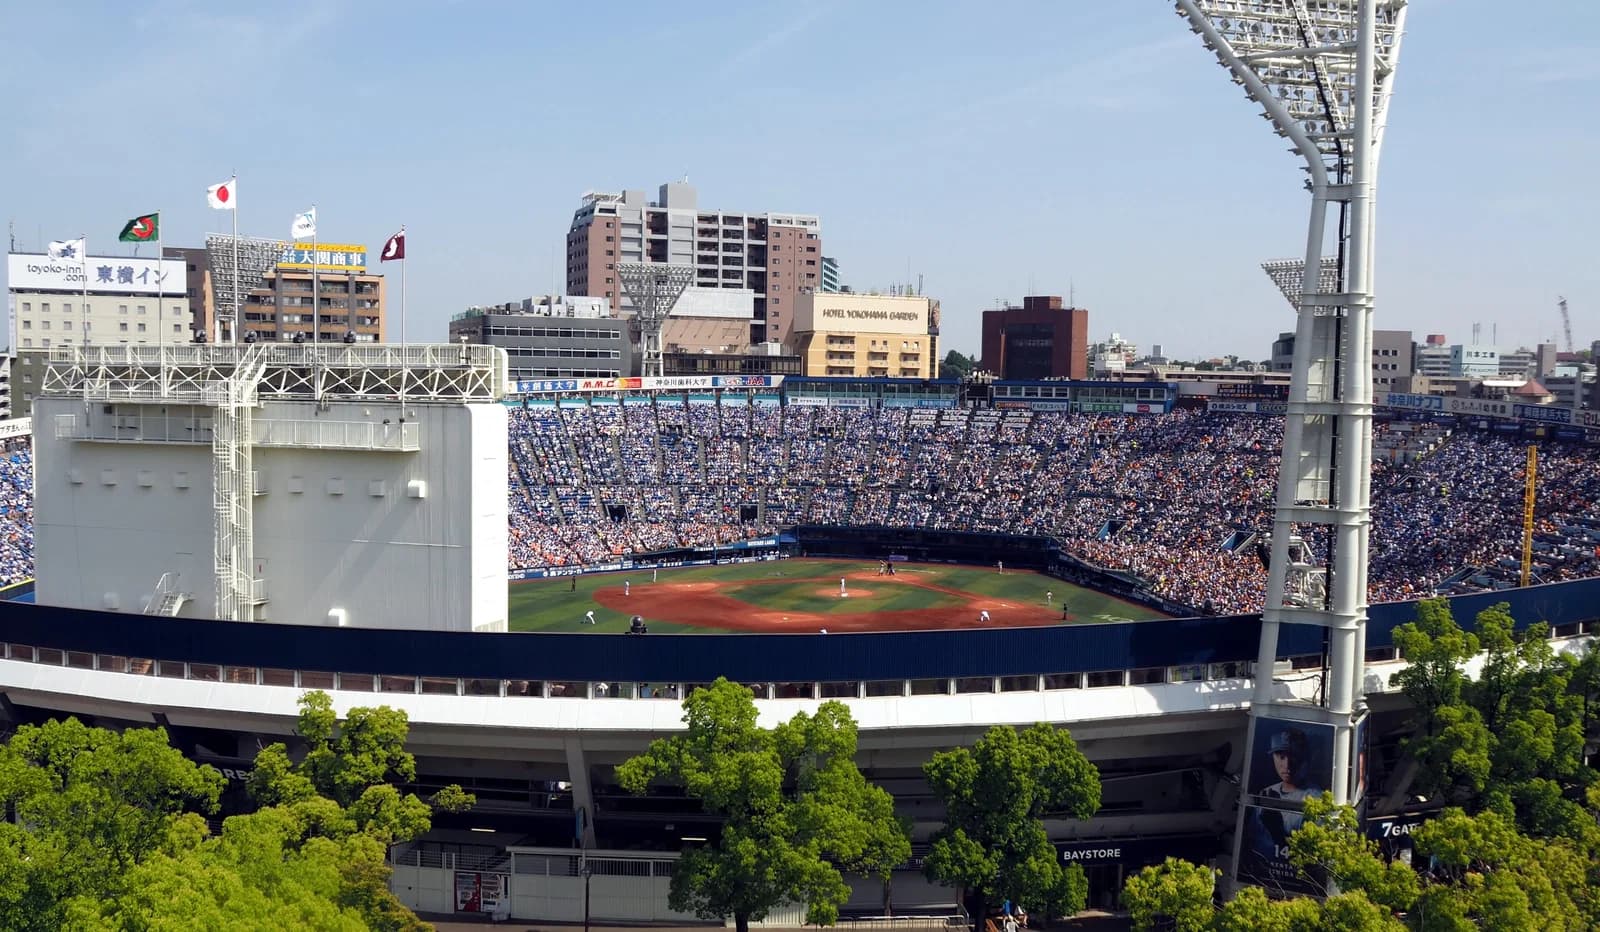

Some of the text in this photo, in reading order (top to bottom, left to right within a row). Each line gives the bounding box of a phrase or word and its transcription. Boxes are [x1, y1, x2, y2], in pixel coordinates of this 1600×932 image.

[300, 250, 362, 265] 大関商事
[27, 264, 81, 274] toyoko-inn
[96, 265, 168, 284] 東横イン
[63, 273, 88, 281] .com
[823, 309, 918, 320] HOTEL YOKOHAMA GARDEN
[1382, 822, 1420, 837] 7GAT
[1064, 848, 1121, 860] BAYSTORE
[1274, 844, 1289, 859] 14
